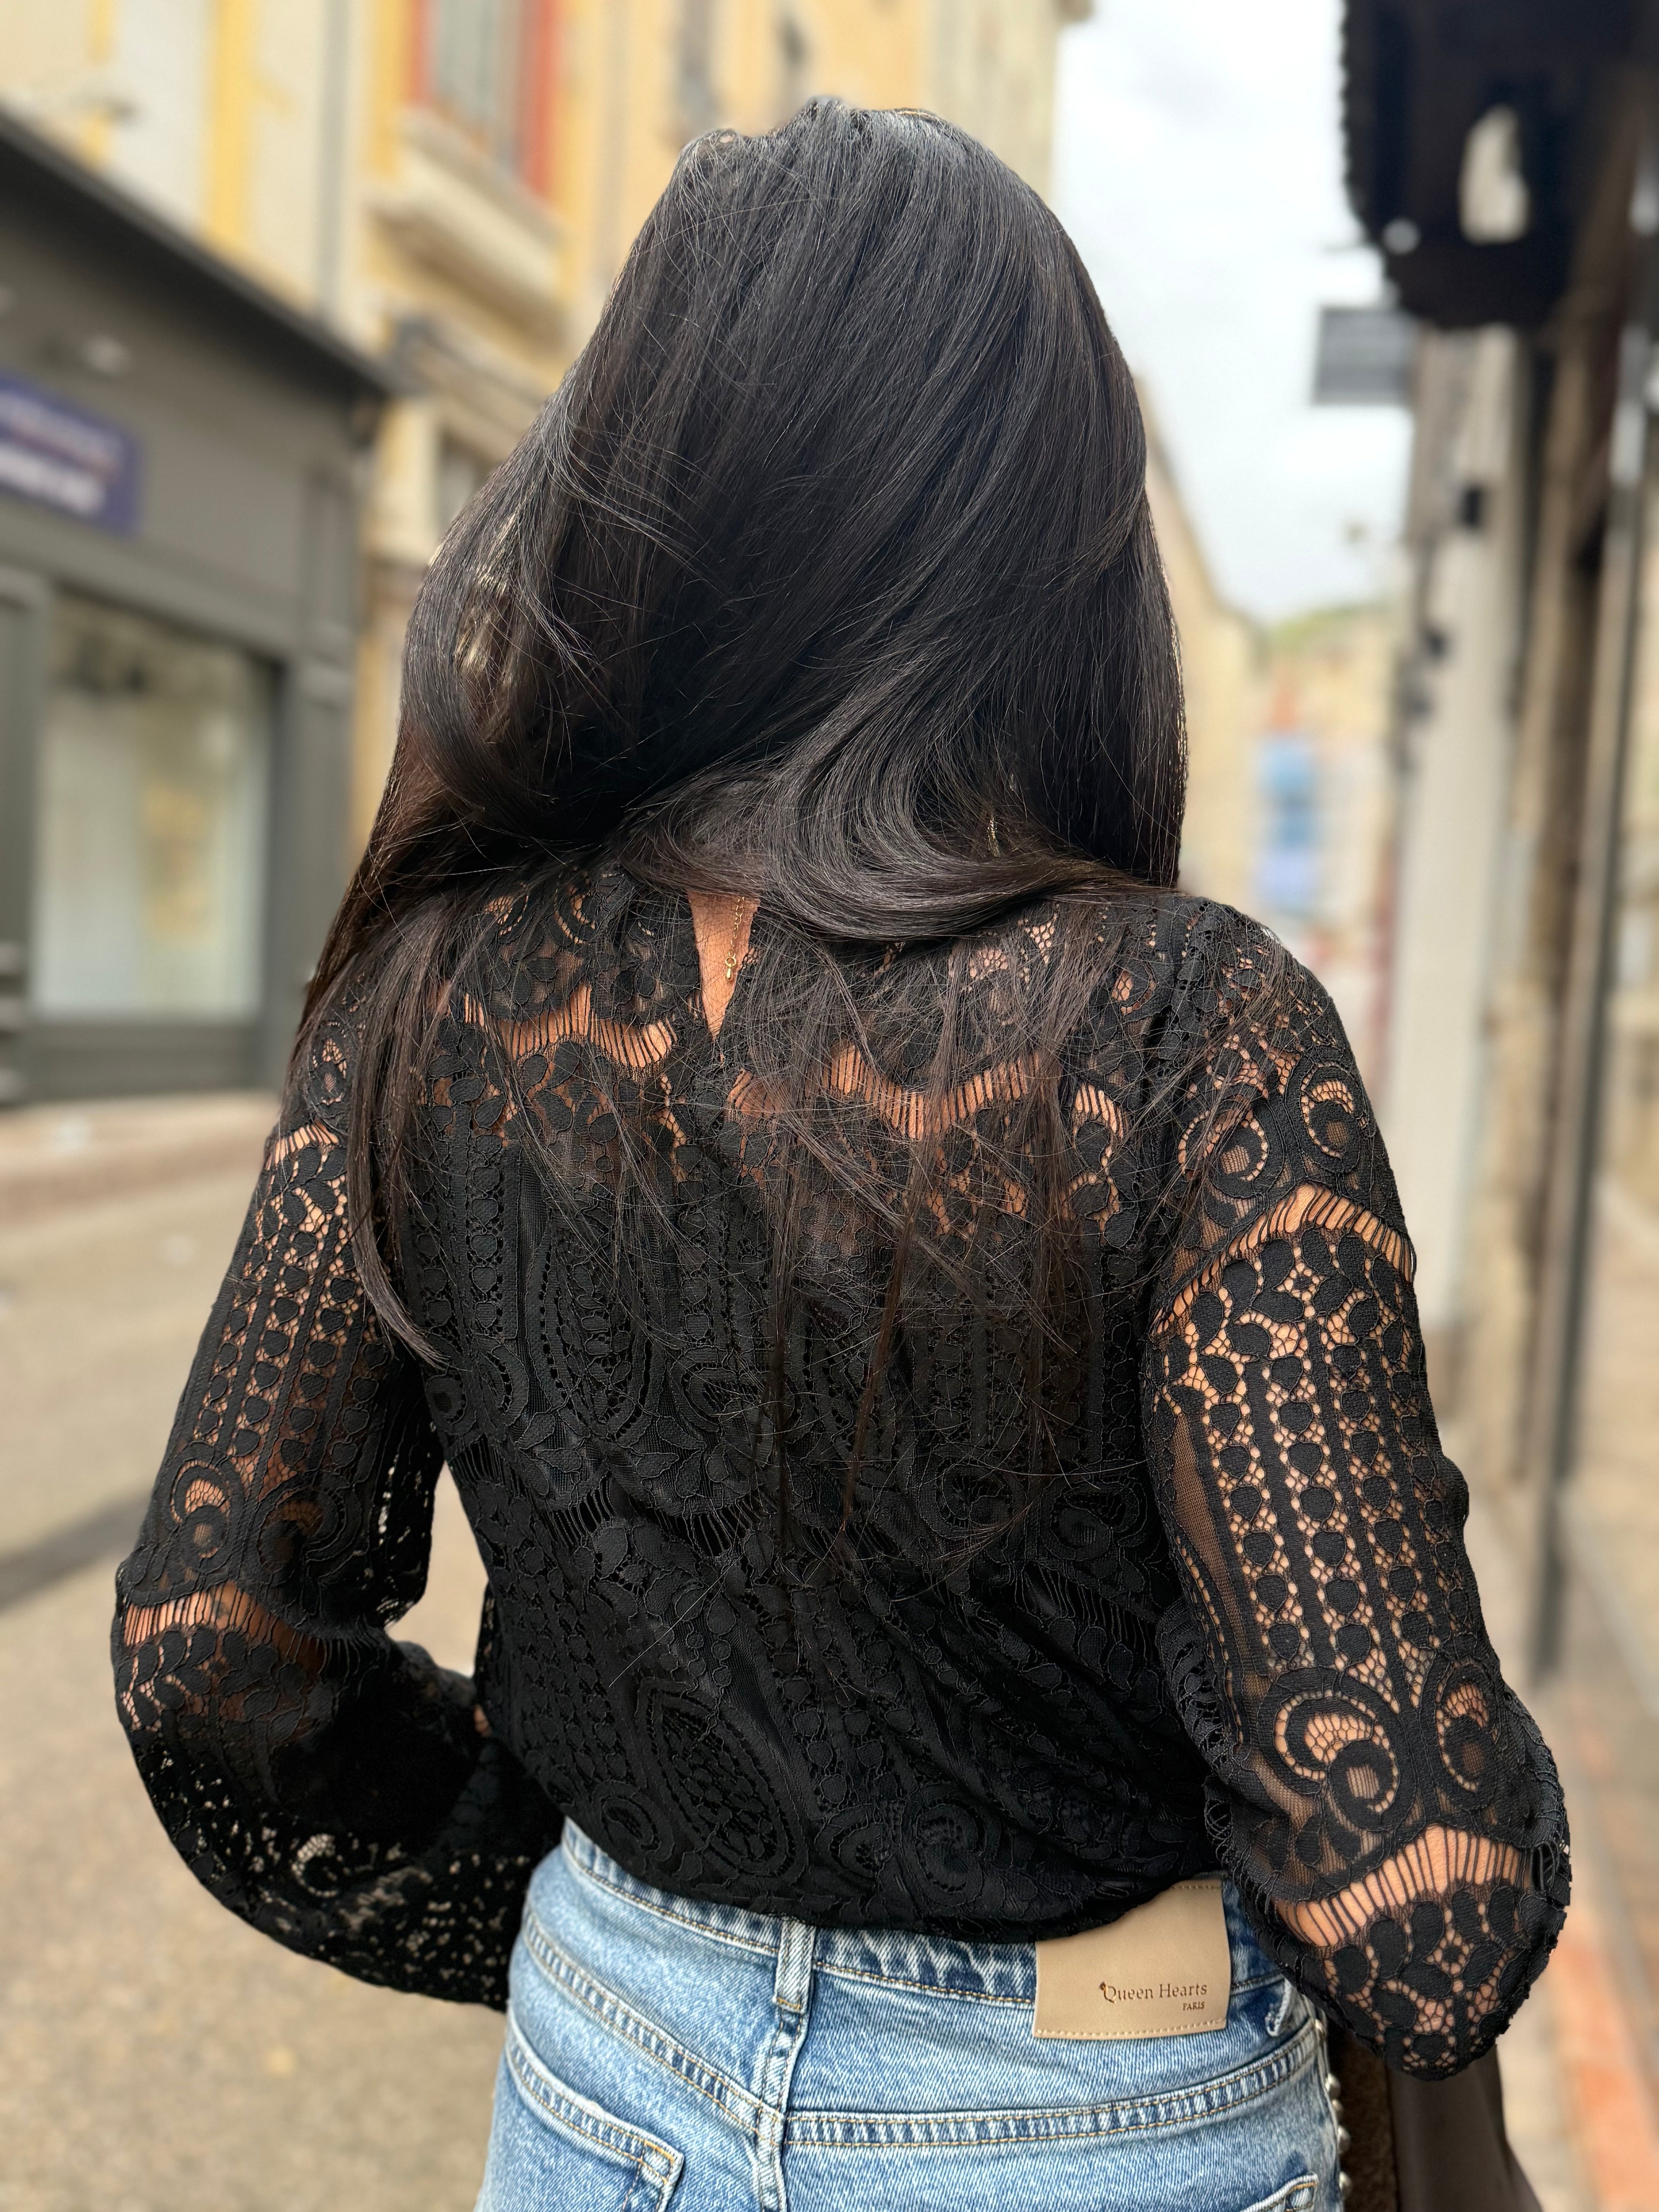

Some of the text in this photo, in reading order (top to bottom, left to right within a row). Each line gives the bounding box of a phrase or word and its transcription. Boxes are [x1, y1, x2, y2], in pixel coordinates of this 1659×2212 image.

[1101, 1982, 1207, 2003] Queen Hearts
[1182, 2002, 1205, 2011] PARIS
